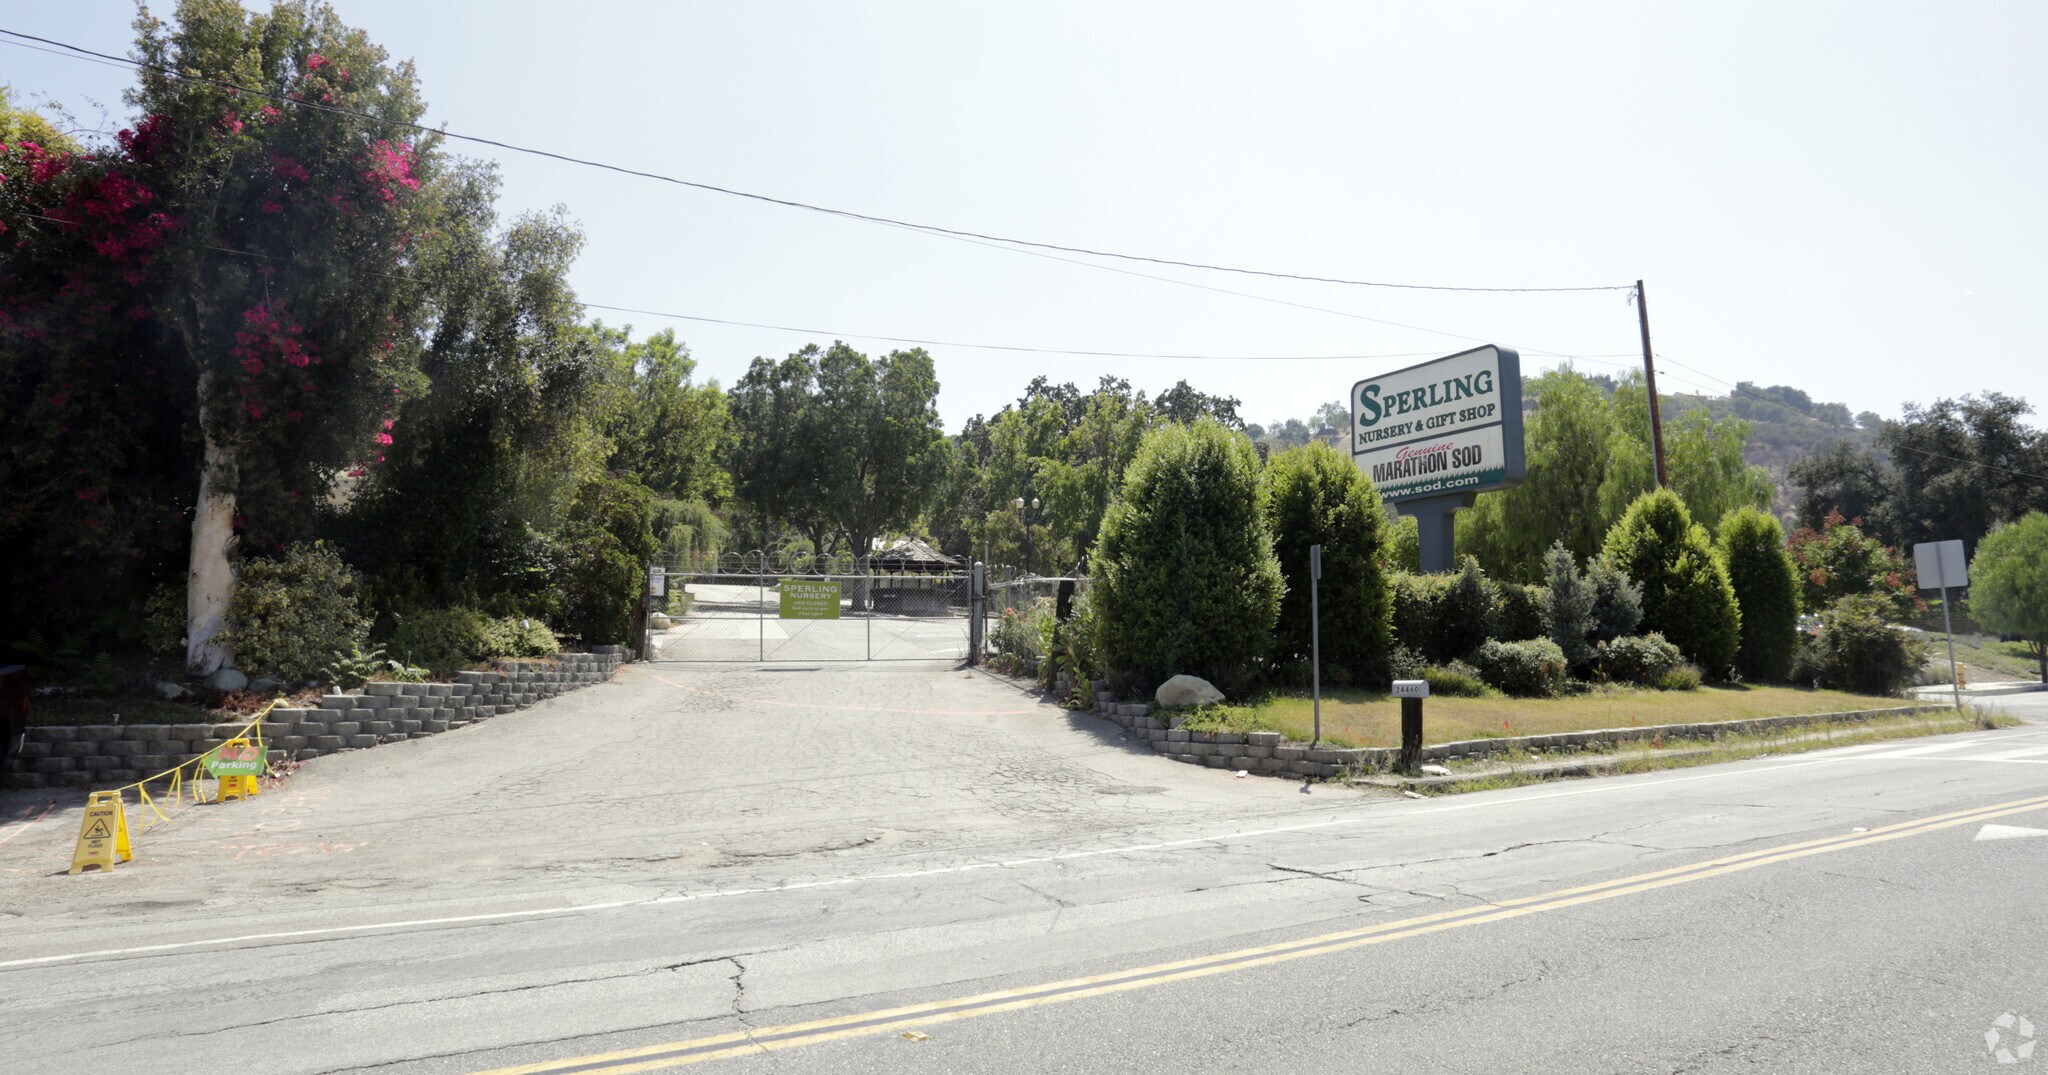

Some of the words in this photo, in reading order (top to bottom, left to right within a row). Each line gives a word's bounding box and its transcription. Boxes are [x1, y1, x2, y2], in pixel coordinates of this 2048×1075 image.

[1359, 370, 1493, 427] SPERLING
[1359, 421, 1413, 444] NURSERY
[1415, 420, 1423, 431] &
[1426, 412, 1456, 430] GIFT
[1459, 403, 1496, 422] SHOP
[1396, 441, 1455, 461] Genuine
[1373, 451, 1447, 483] MARATHON
[1452, 444, 1482, 469] SOD
[1380, 476, 1479, 499] www.sod.com
[783, 584, 838, 593] SPERLING
[211, 761, 257, 770] Parking
